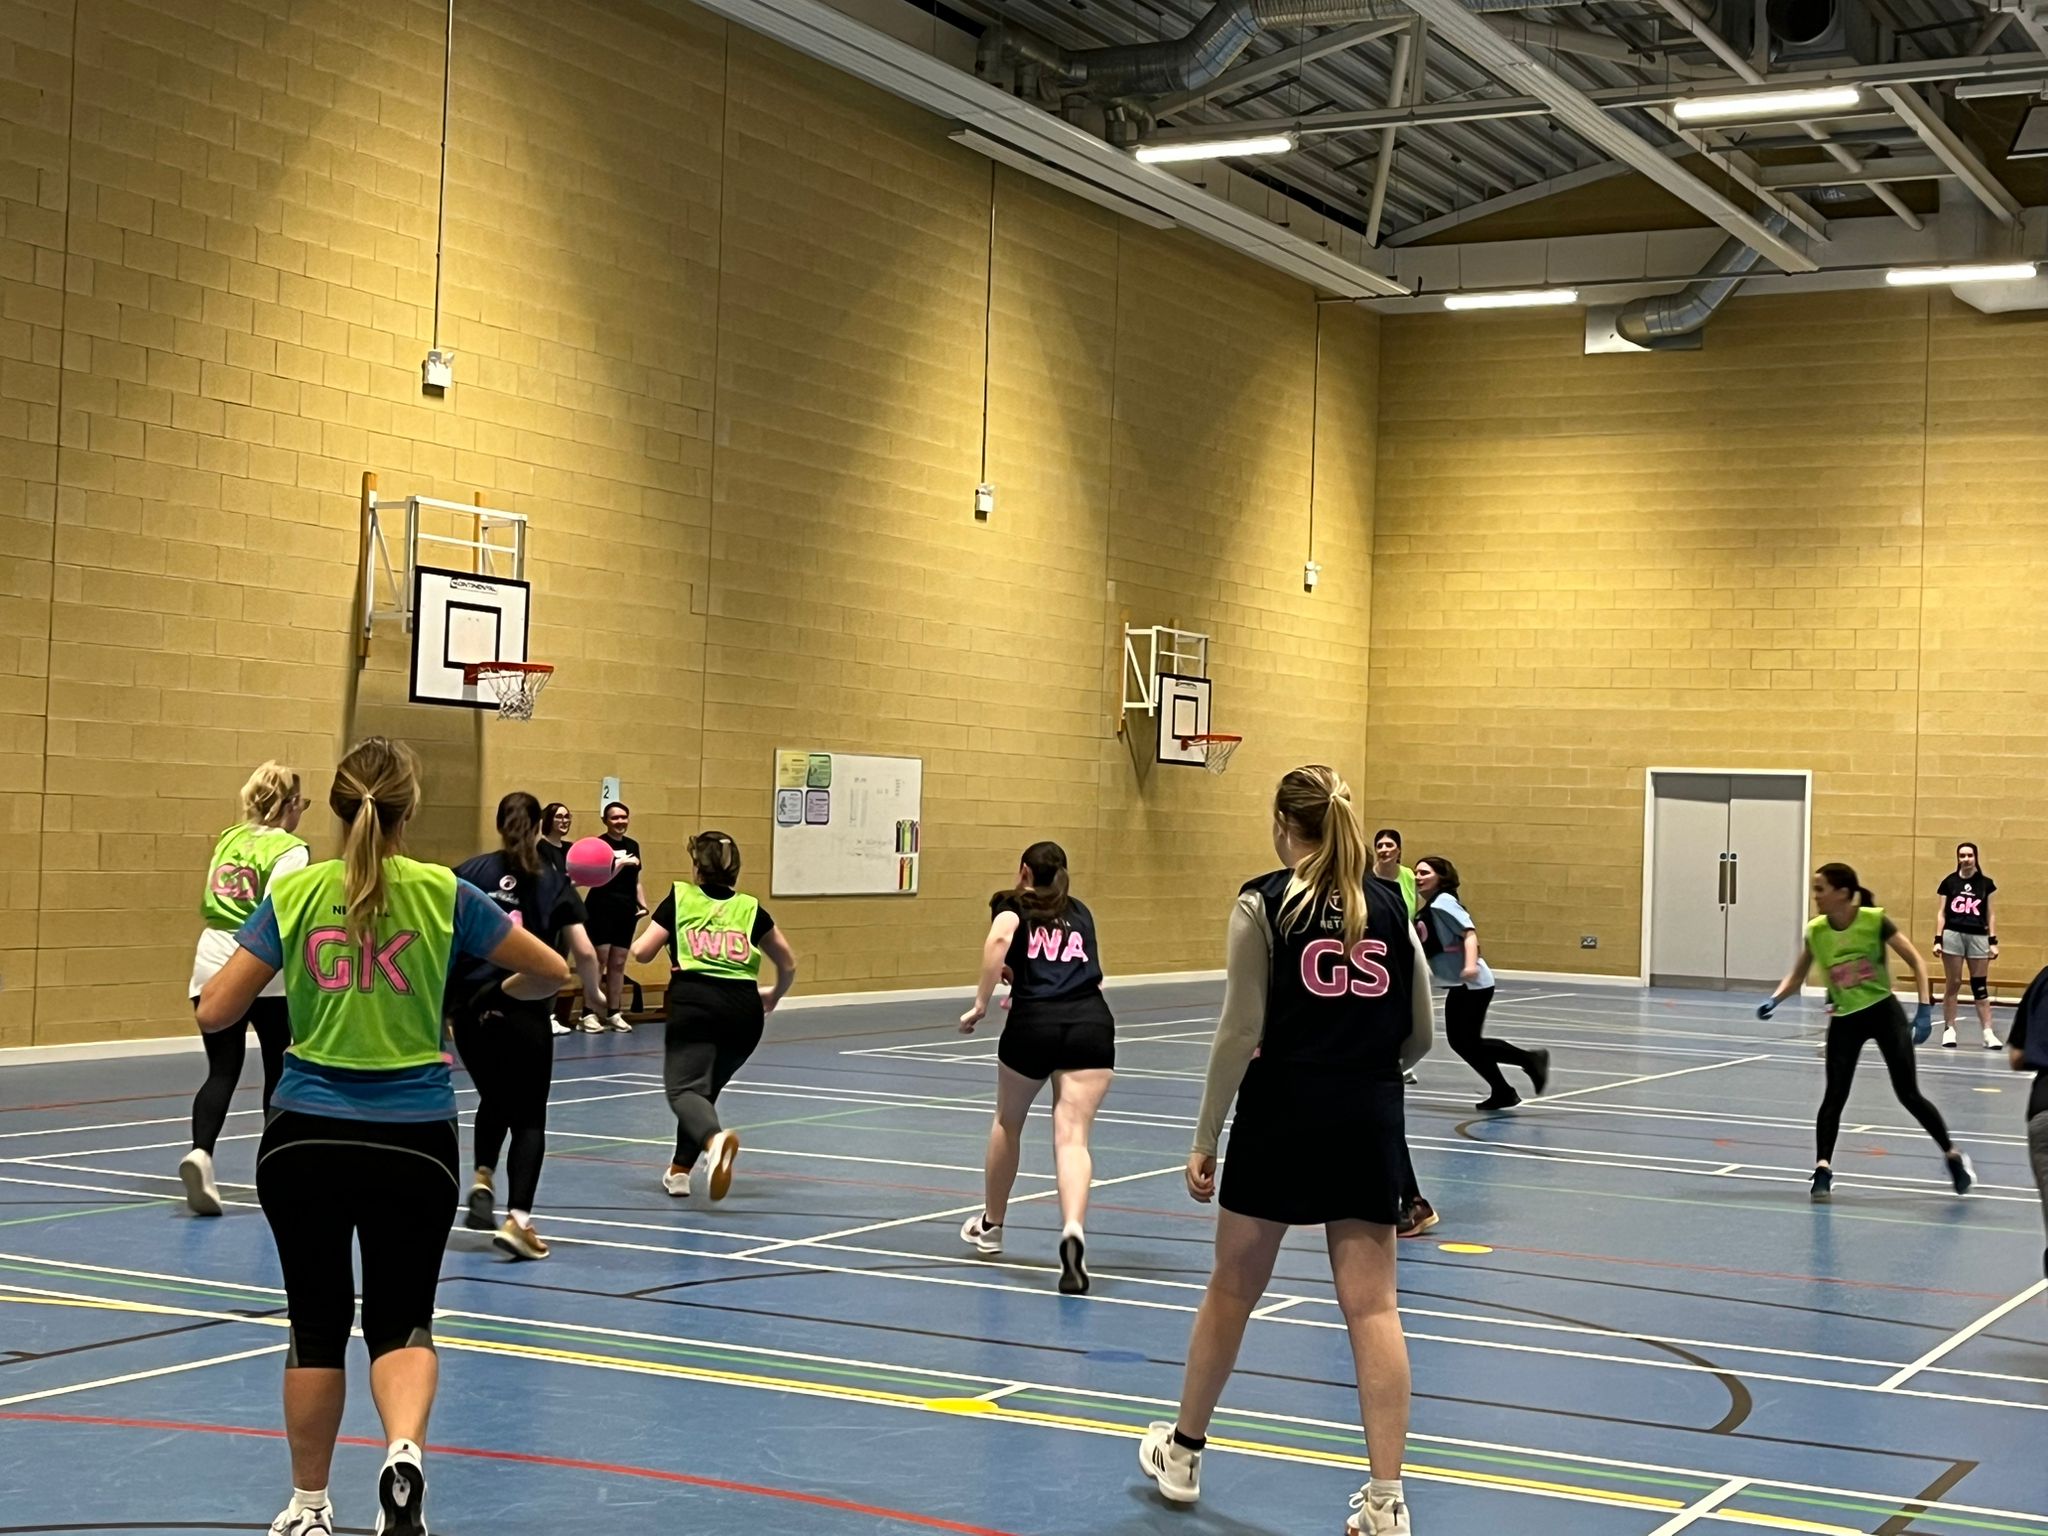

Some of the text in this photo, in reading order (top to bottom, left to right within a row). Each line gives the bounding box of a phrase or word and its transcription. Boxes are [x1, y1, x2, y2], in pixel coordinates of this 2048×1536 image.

[603, 785, 610, 799] 2
[1950, 895, 1982, 916] GK
[304, 926, 420, 995] GK
[685, 928, 751, 964] WD
[1027, 926, 1089, 962] WA
[1300, 938, 1390, 997] GS
